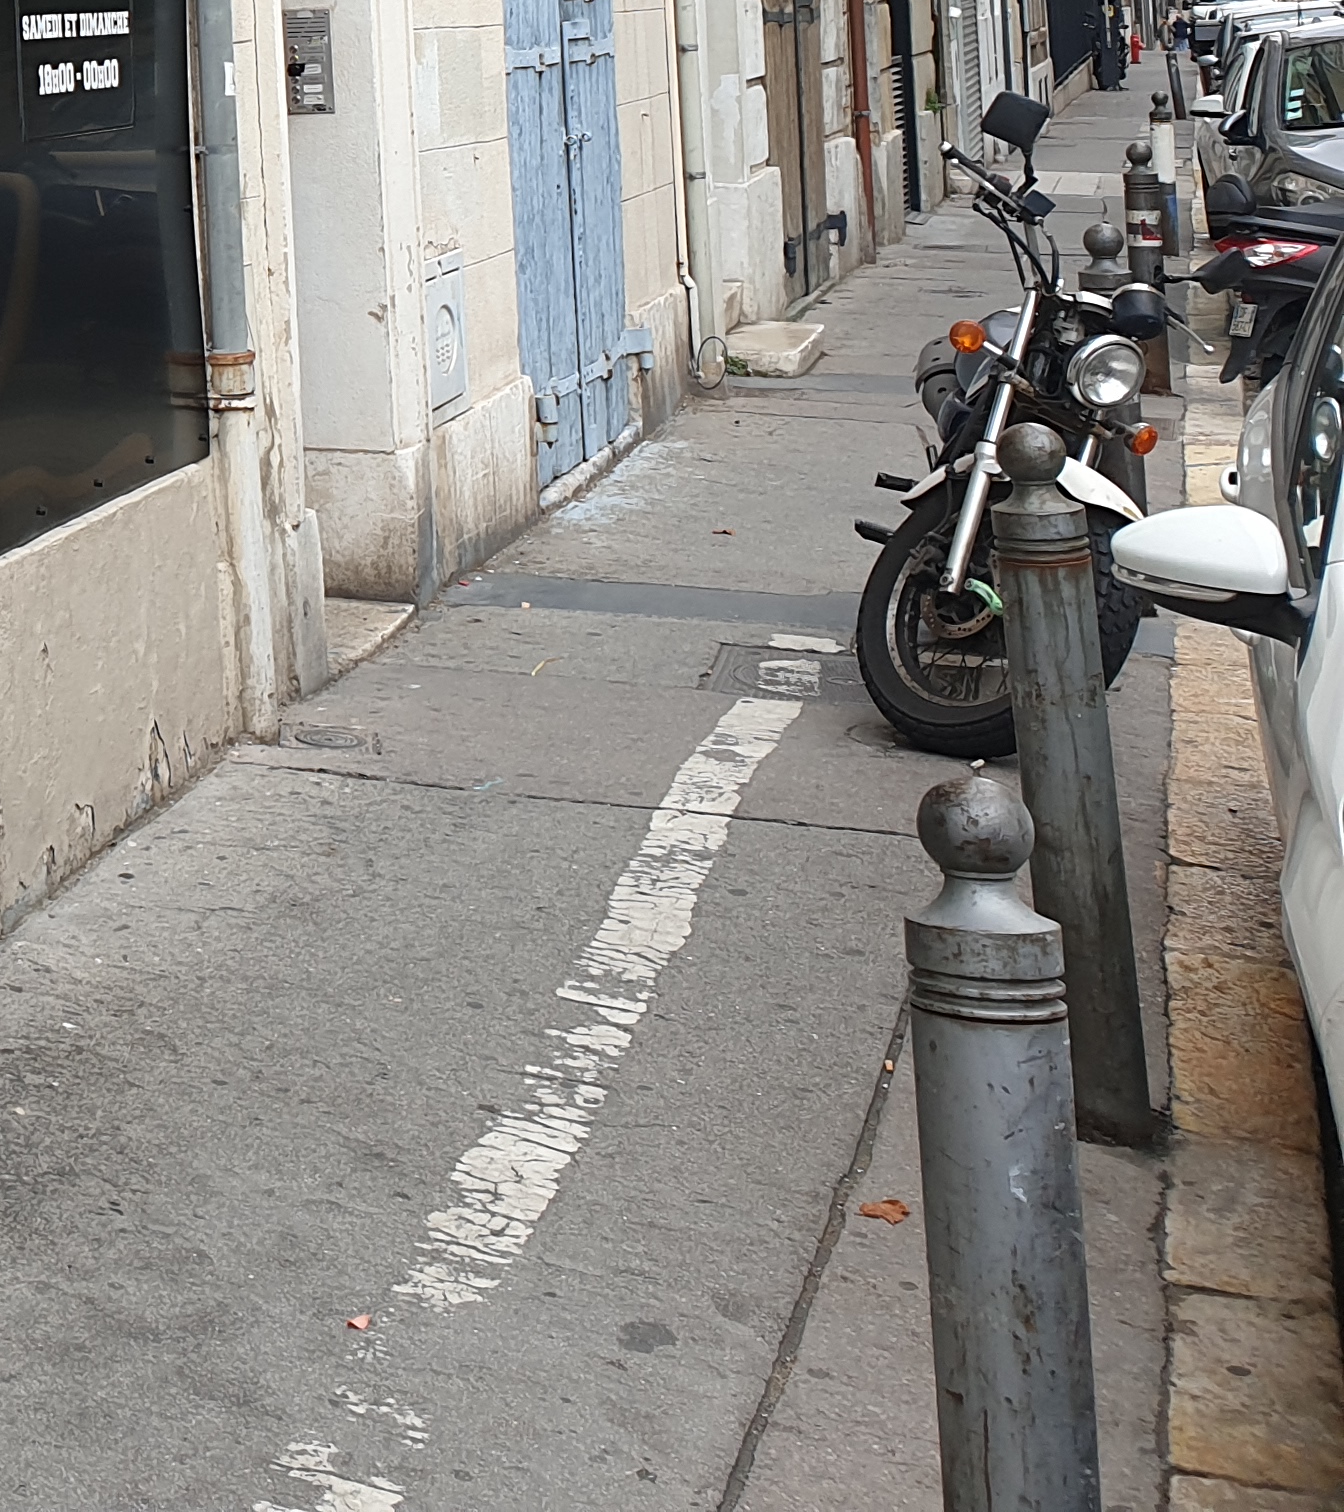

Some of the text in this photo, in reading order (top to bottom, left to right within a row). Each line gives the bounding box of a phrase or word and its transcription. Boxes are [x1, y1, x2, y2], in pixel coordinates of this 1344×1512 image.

[21, 10, 130, 41] SAMEDI ET DIMANCHE
